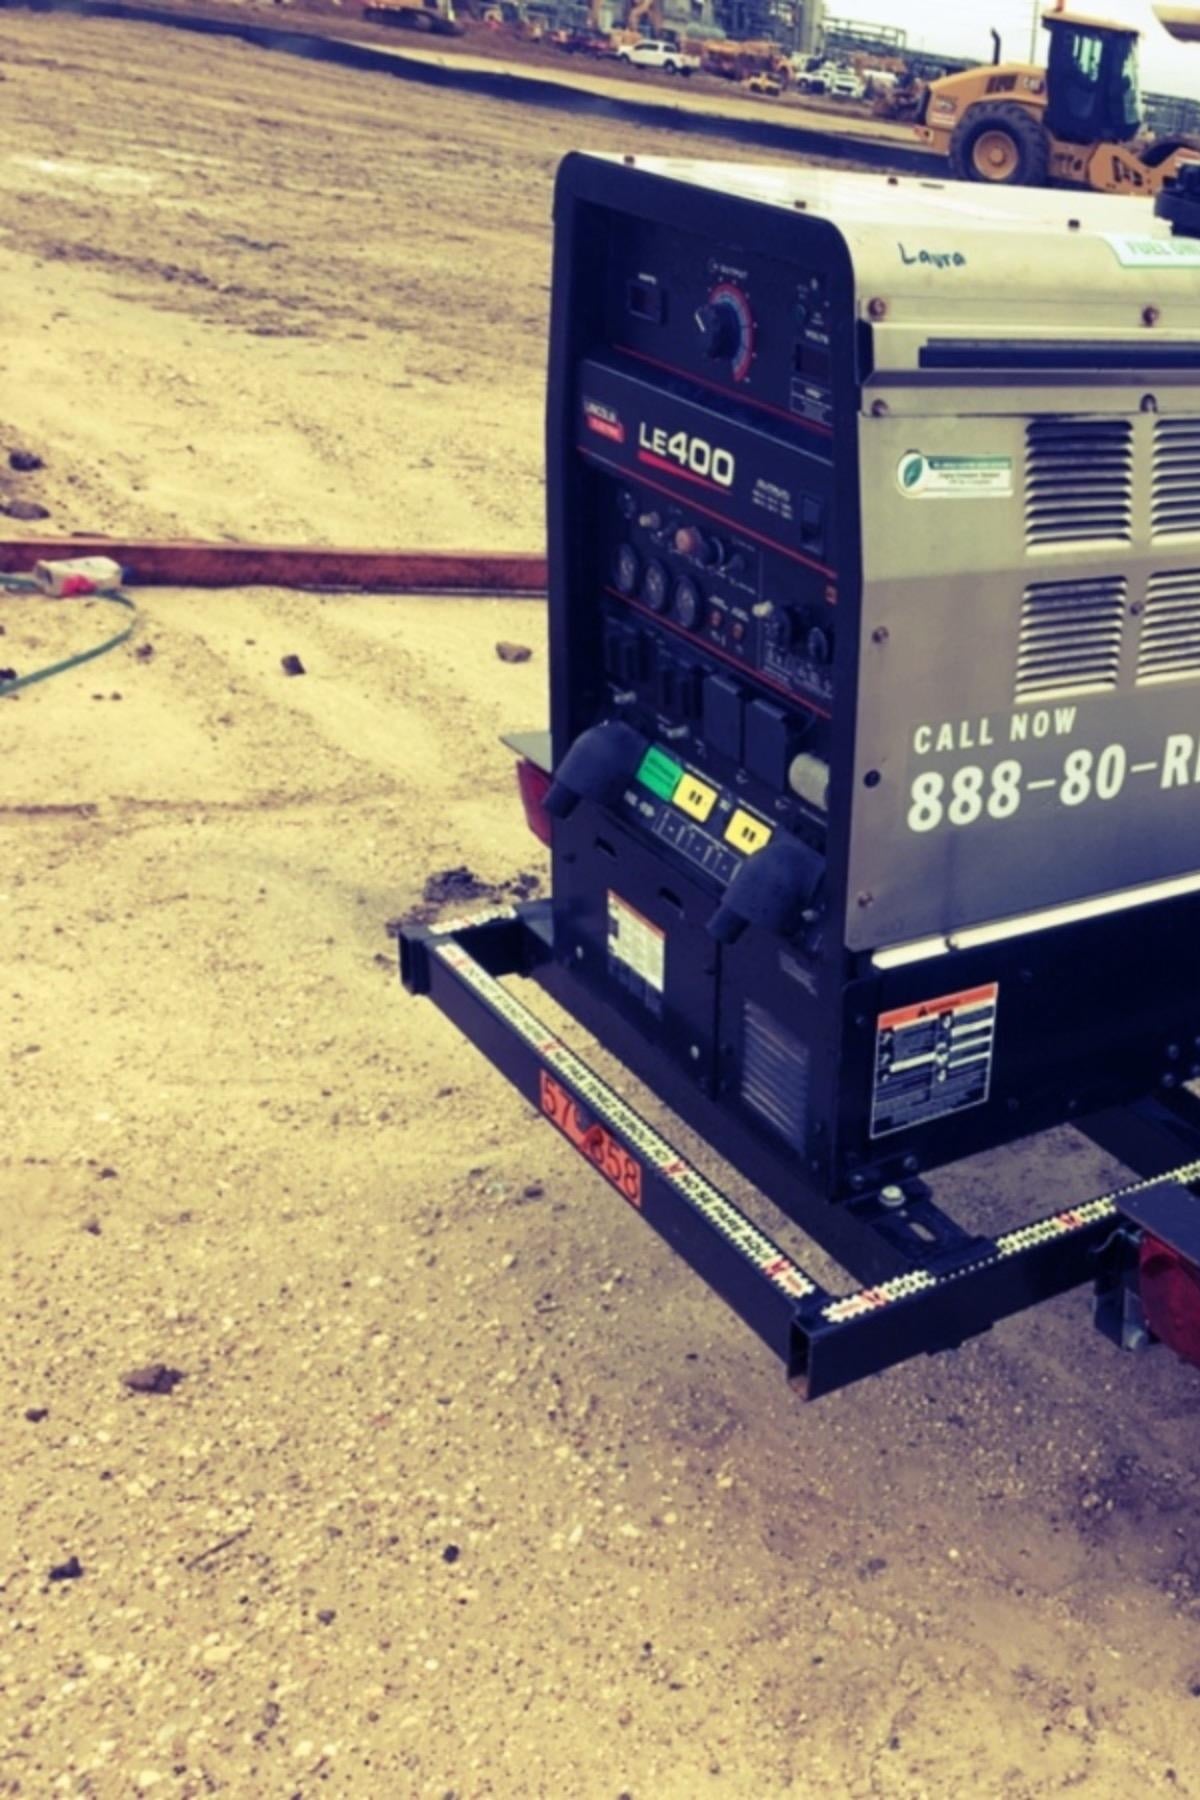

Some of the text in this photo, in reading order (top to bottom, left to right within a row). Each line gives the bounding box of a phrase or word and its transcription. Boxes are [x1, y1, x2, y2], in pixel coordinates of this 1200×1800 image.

[639, 421, 735, 487] LE400
[913, 706, 1077, 755] CALL NOW
